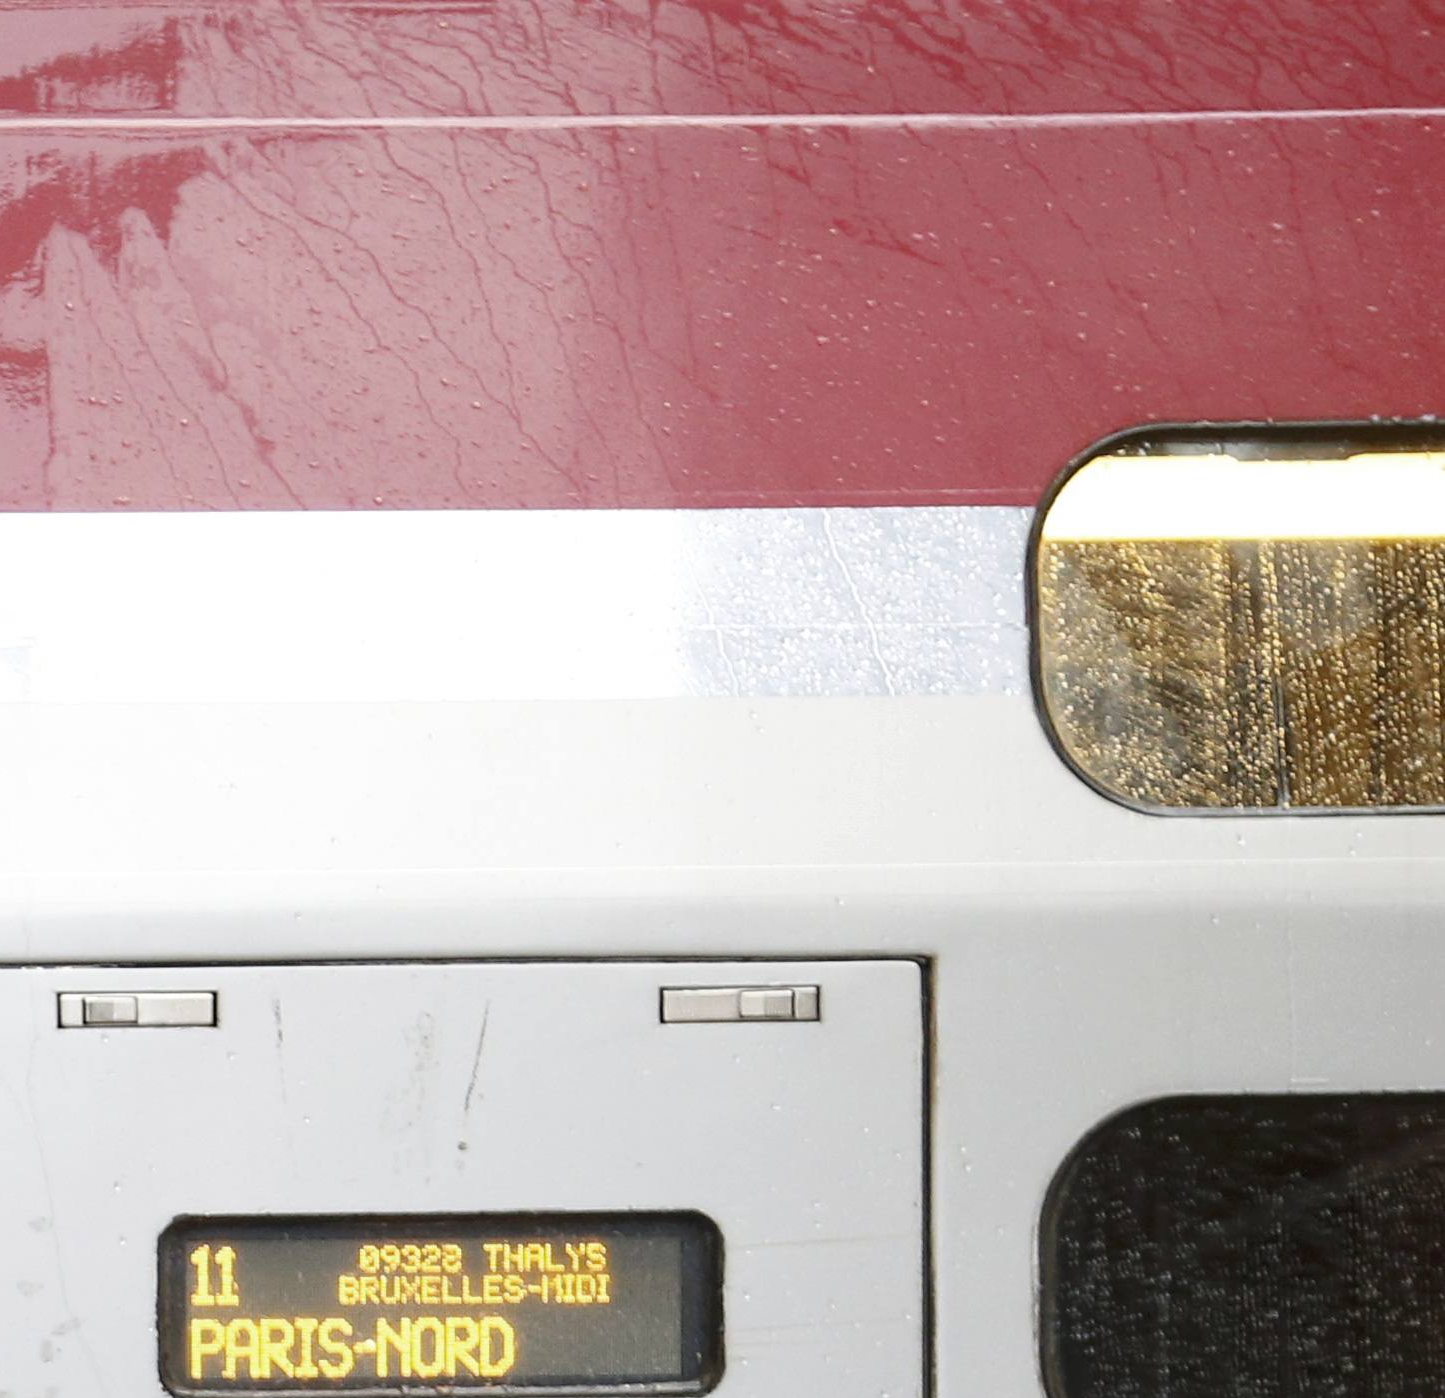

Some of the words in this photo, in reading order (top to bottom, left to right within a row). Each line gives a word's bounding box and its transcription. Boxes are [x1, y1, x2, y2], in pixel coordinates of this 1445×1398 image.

[190, 1244, 238, 1305] 11
[484, 1243, 606, 1273] THALYS
[339, 1275, 610, 1305] BRUXELLES-MIDI
[190, 1317, 516, 1379] PARIS-NORD
